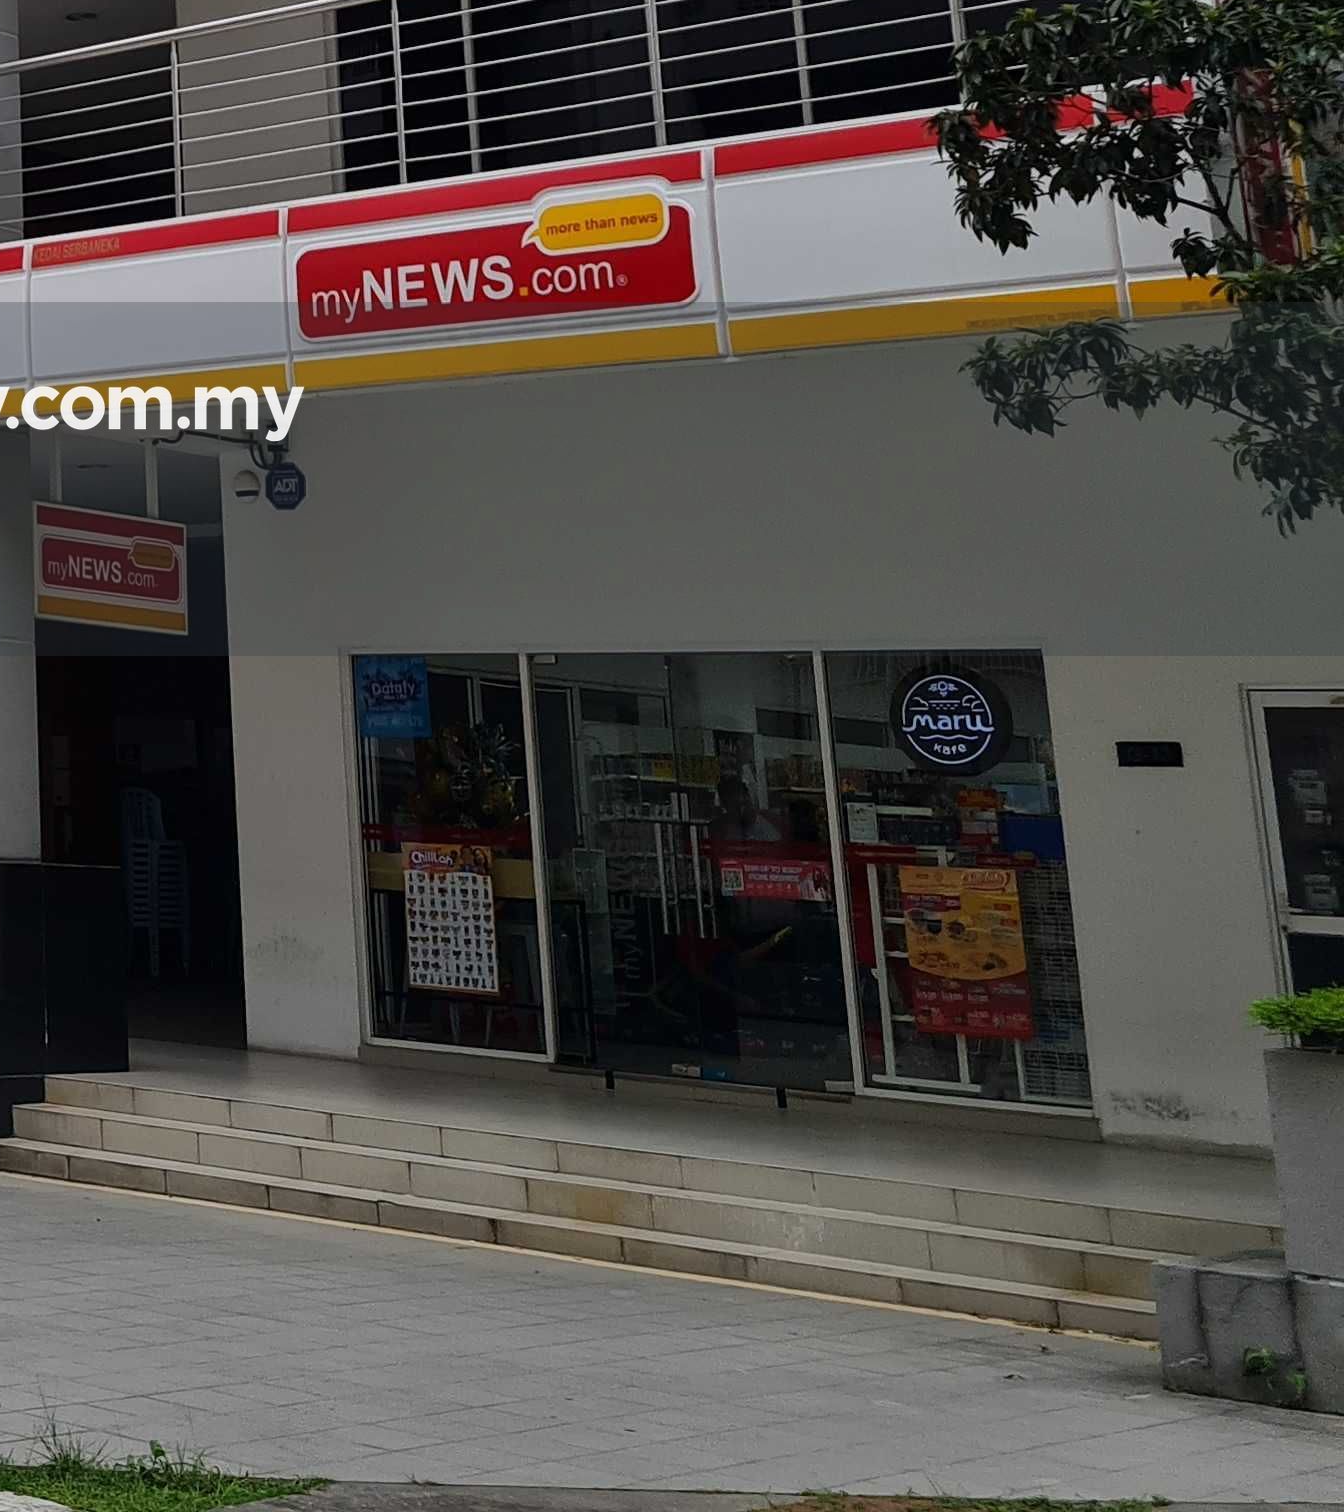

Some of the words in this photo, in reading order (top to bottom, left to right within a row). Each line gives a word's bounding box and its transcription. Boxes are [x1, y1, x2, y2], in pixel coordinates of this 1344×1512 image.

[545, 221, 582, 237] more
[585, 216, 616, 232] than
[620, 211, 658, 228] news
[311, 255, 615, 322] myNEWS.com
[274, 478, 298, 493] ADT
[47, 554, 157, 588] myNEWS.com
[902, 713, 995, 732] maru
